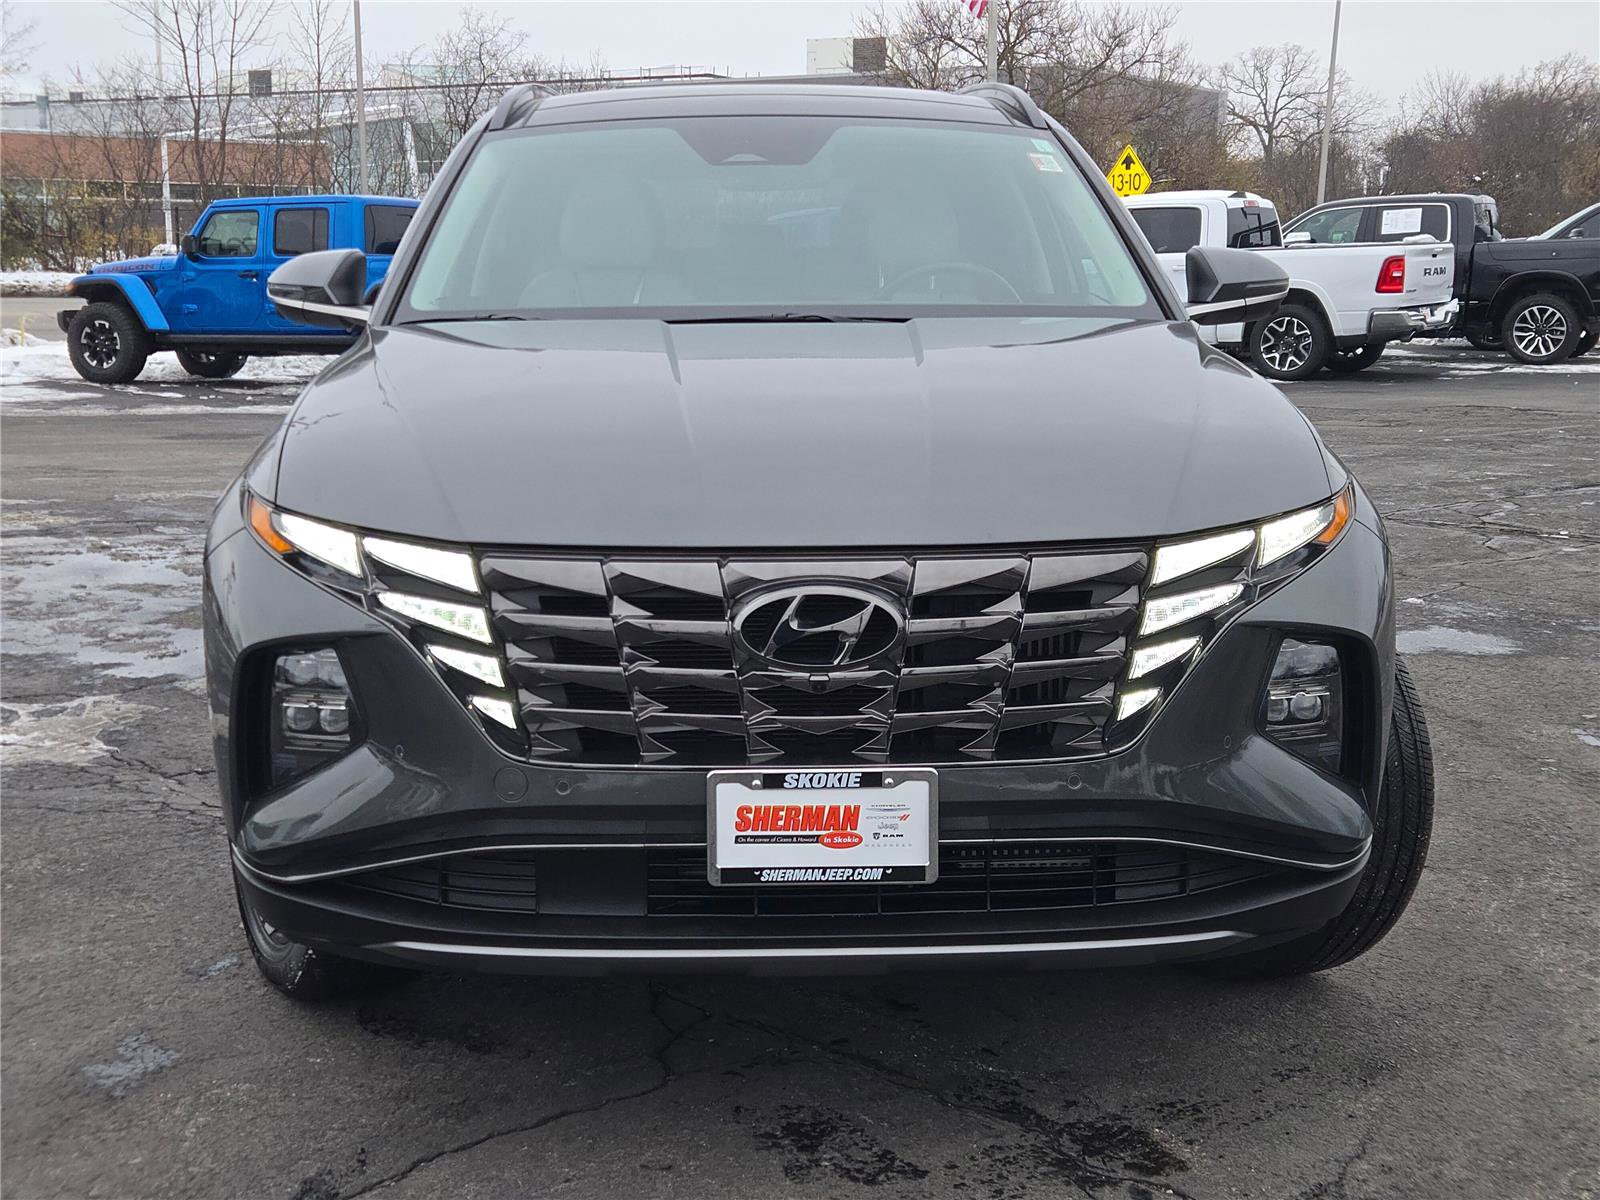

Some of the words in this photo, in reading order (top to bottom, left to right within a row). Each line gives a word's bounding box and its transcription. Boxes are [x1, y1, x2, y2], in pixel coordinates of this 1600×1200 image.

[1424, 267, 1447, 276] RAM
[783, 772, 862, 789] SKOKIE
[735, 804, 861, 832] SHERMAN
[833, 835, 859, 843] Skokie
[761, 868, 882, 882] SHERMANJEEP.COM
